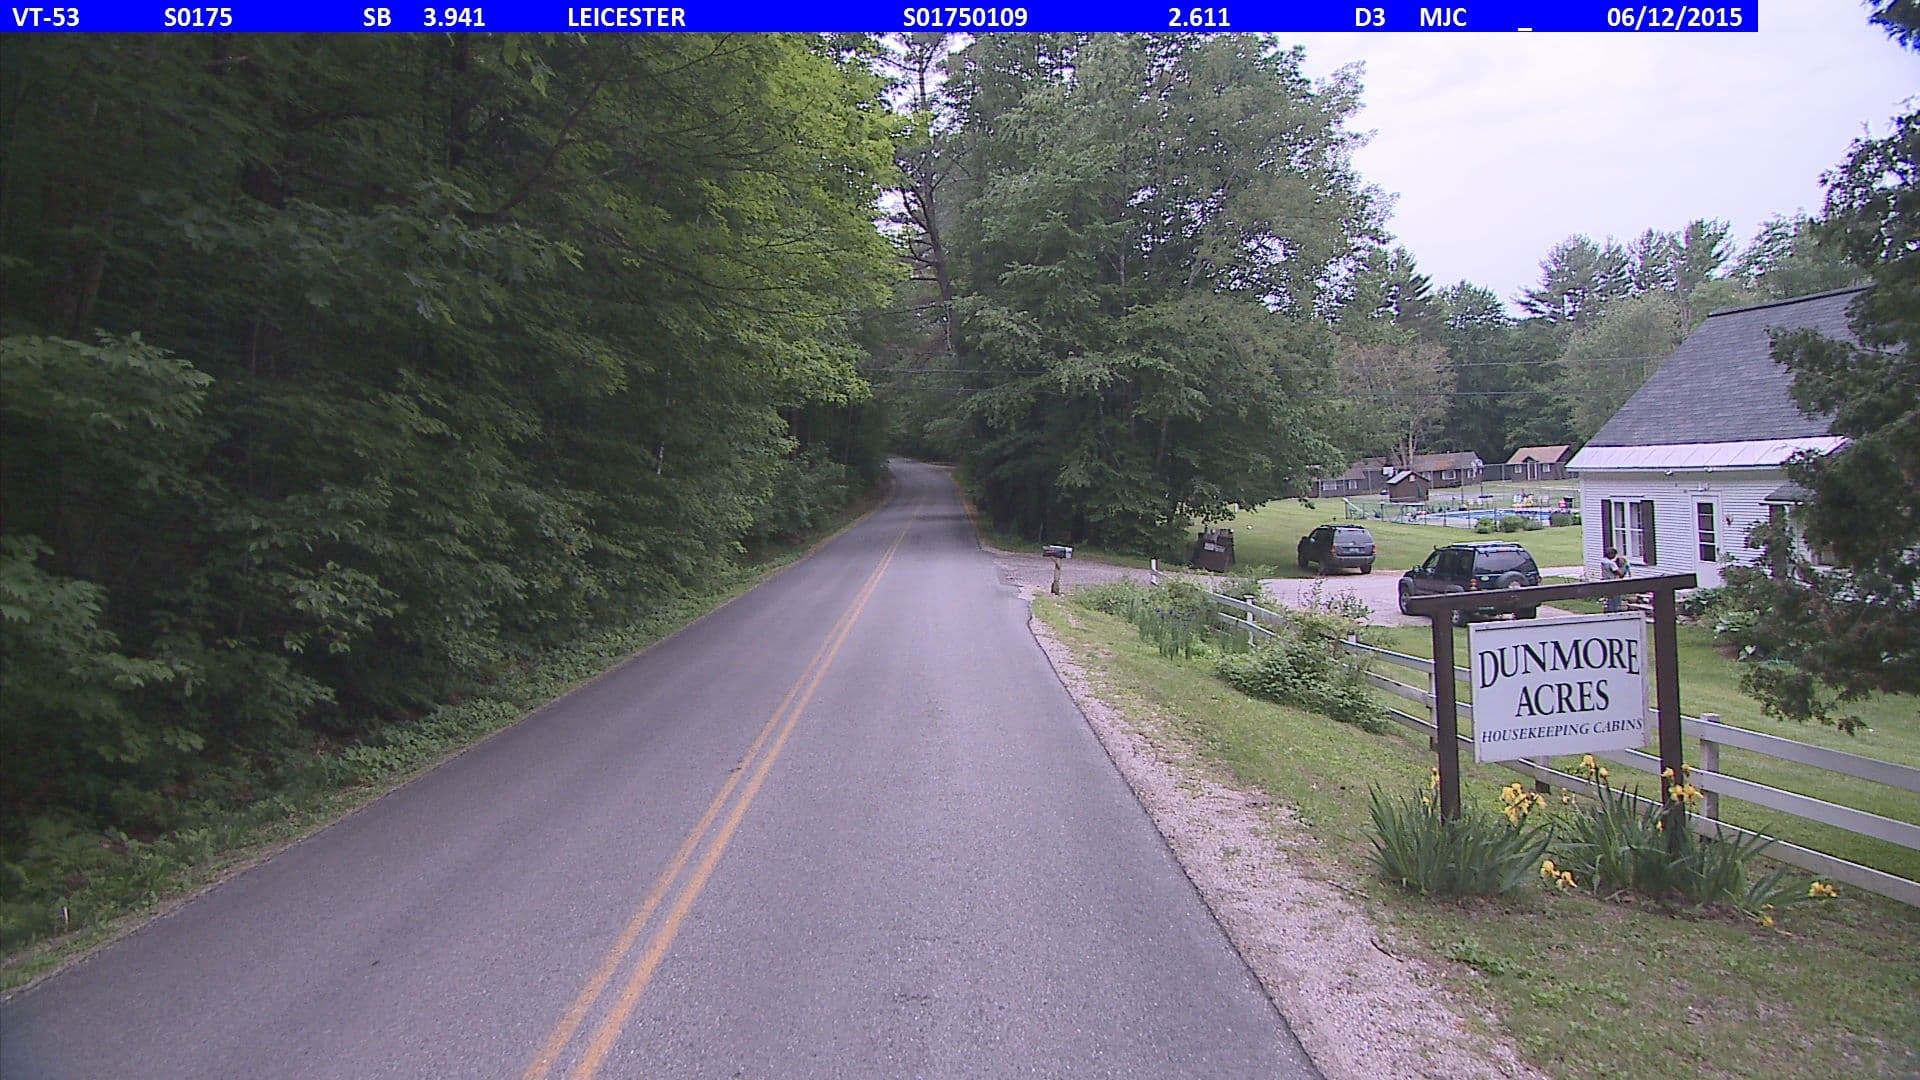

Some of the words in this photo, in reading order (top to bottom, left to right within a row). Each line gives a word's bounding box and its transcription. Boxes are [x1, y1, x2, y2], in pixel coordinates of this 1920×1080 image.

[1478, 638, 1640, 689] DUNMORE
[1515, 679, 1610, 717] ACRES
[1482, 722, 1590, 743] HOUSEKEEPING
[1593, 718, 1643, 733] CABINS
